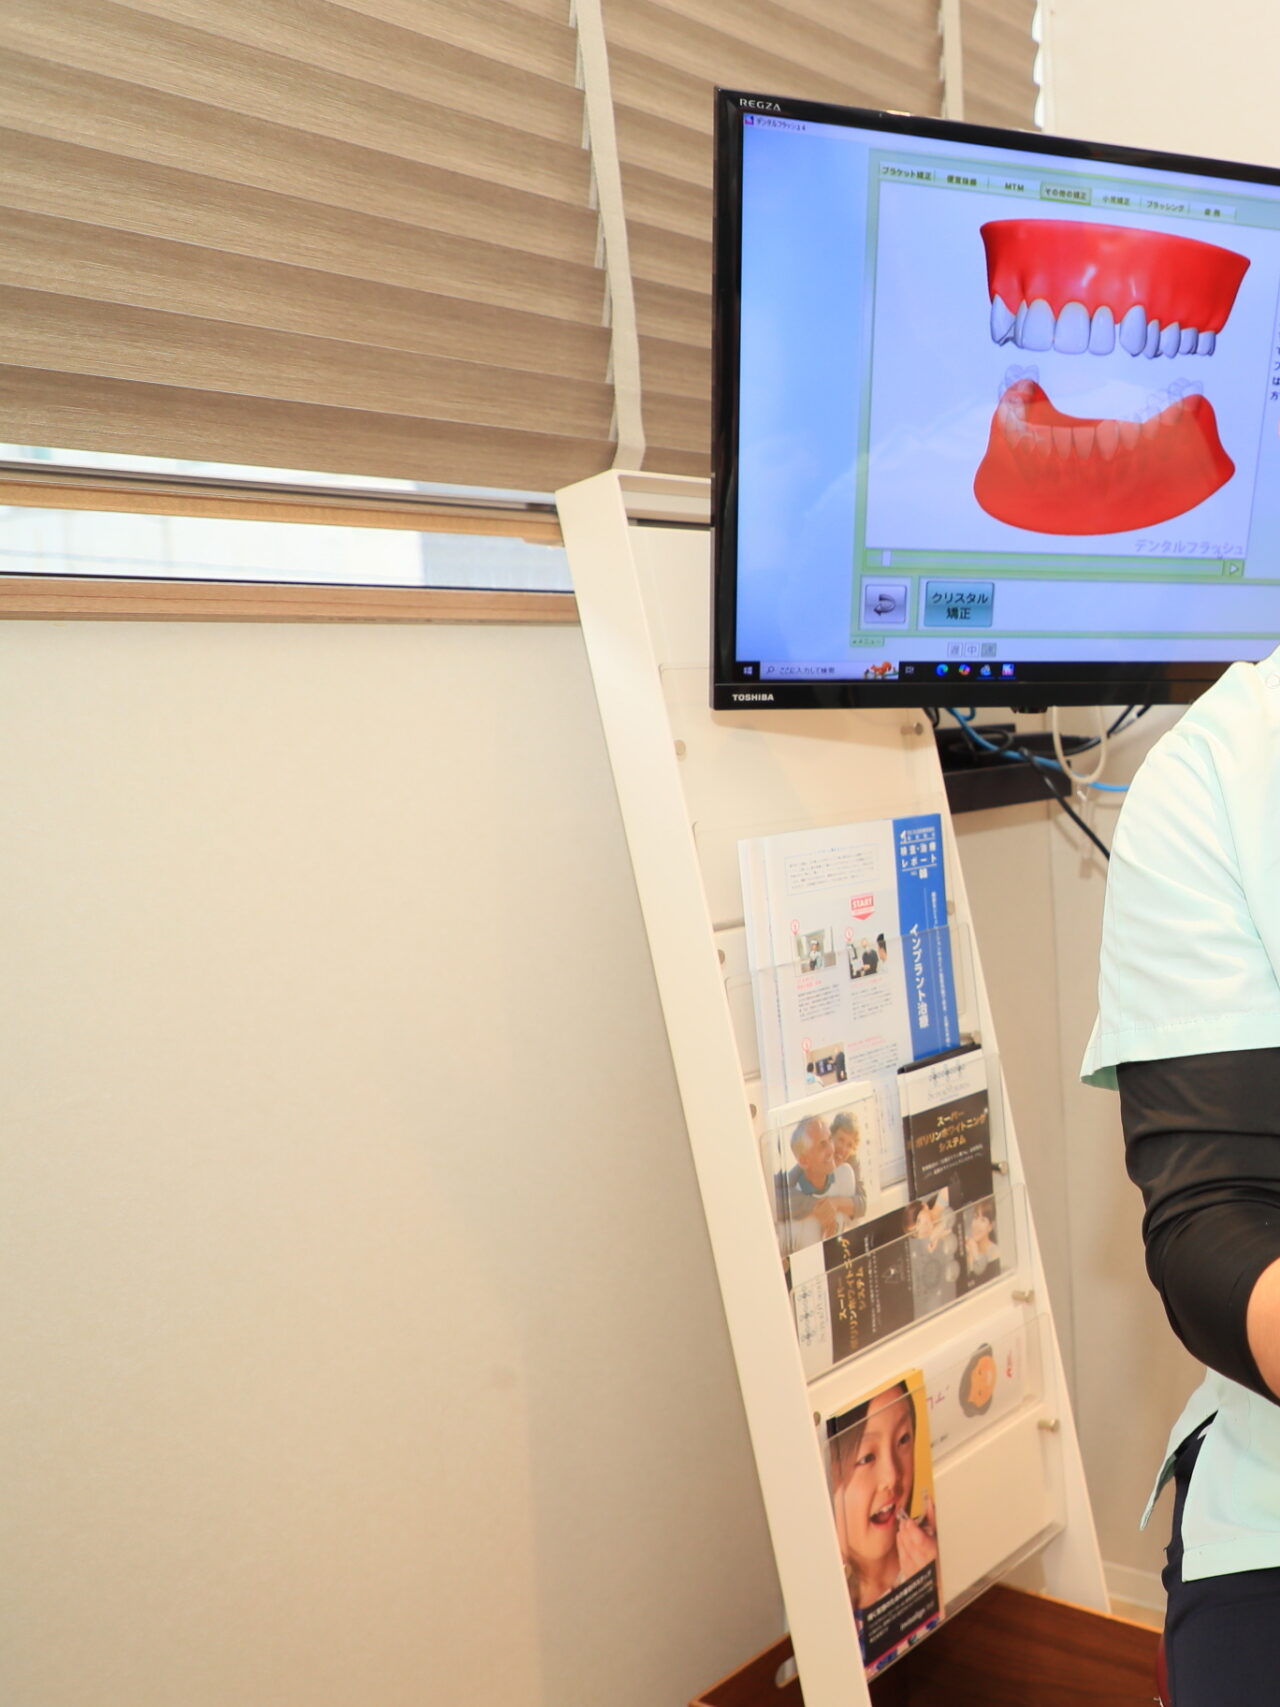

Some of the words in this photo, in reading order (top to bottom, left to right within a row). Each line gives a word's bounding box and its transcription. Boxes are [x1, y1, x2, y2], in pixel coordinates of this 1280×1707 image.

[739, 98, 781, 111] REGZA
[1005, 182, 1024, 191] MTM
[1135, 539, 1244, 555] デンタルフラッシュ
[932, 592, 989, 605] クリスタル
[946, 606, 972, 620] 矯正
[732, 693, 775, 702] TOSHIBA
[901, 853, 938, 868] レポート
[852, 896, 873, 909] START
